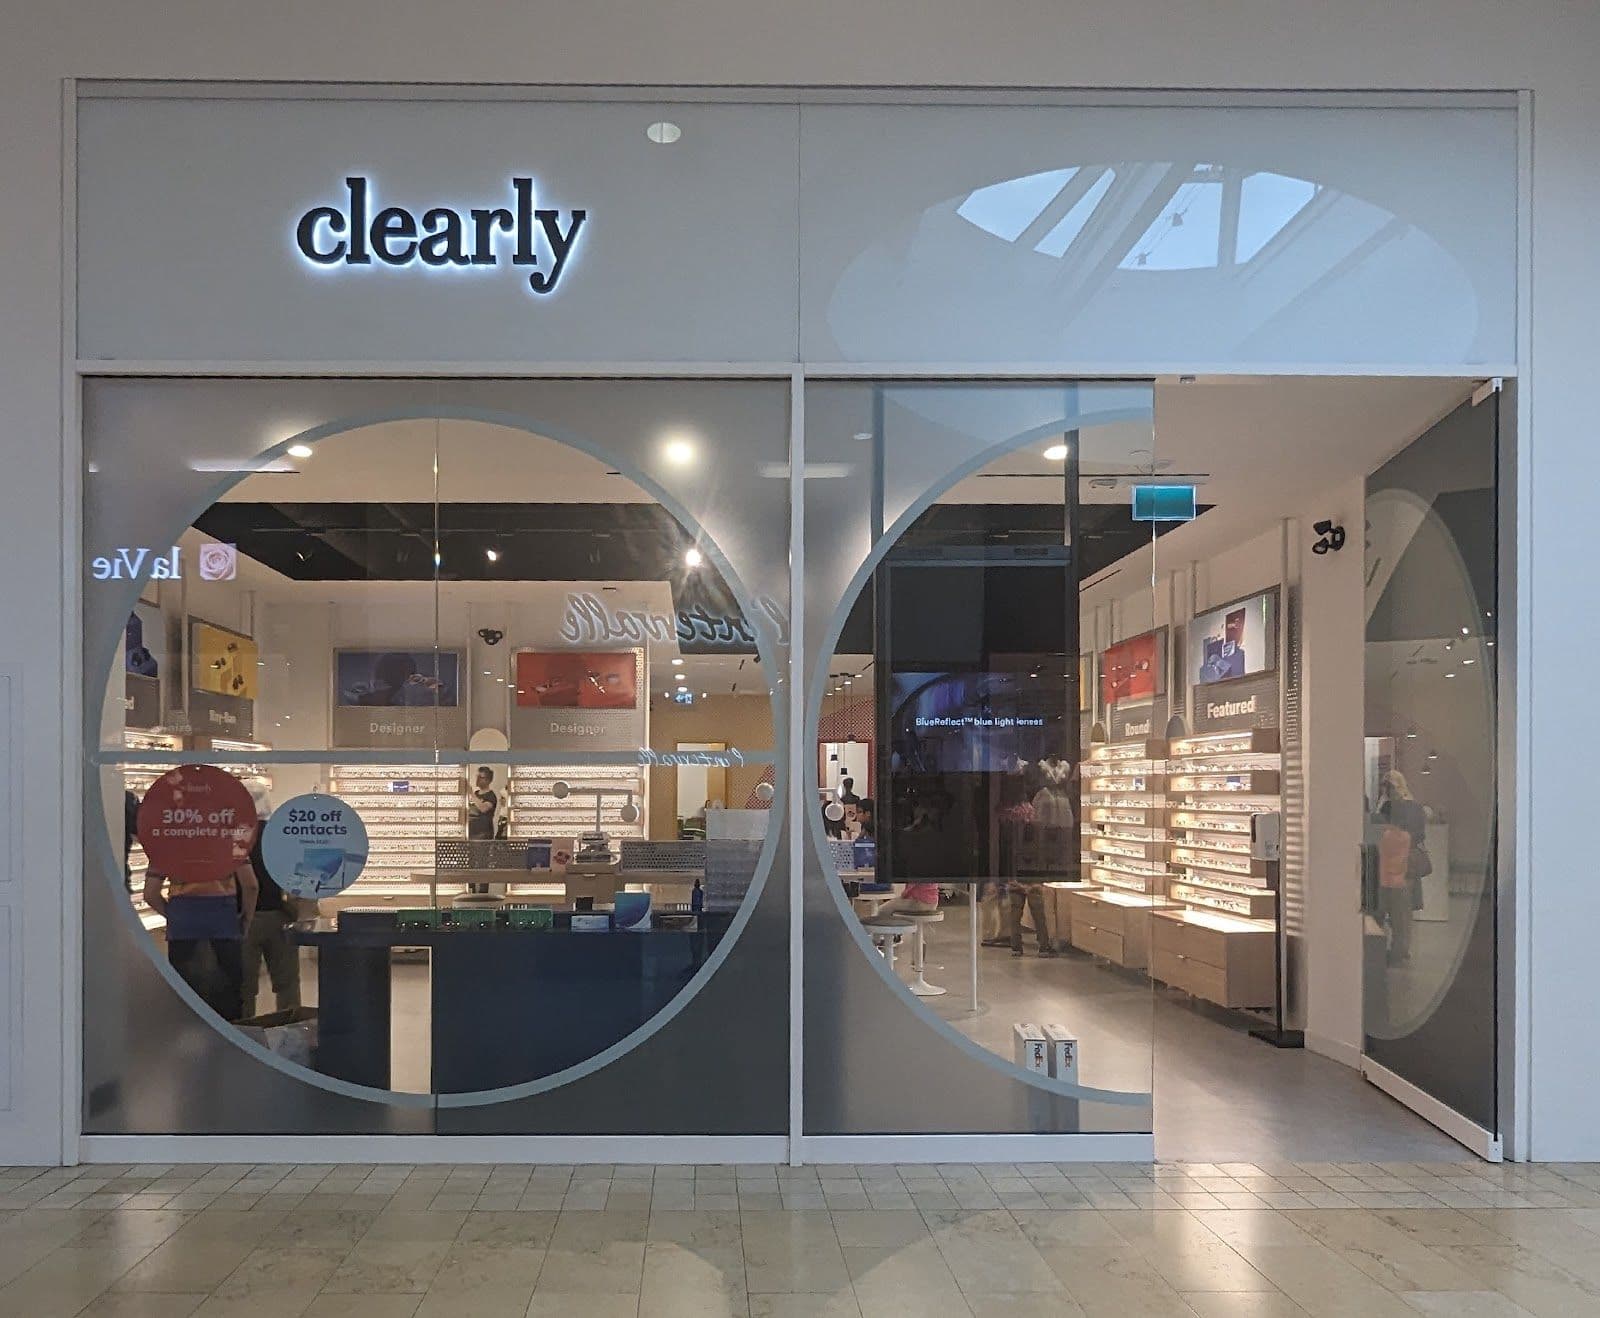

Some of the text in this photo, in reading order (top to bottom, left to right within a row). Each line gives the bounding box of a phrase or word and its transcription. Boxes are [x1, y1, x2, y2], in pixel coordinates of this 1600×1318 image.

[296, 176, 587, 294] clearly
[1207, 695, 1257, 719] Featured
[370, 722, 425, 737] Designer
[550, 721, 607, 736] Designer
[974, 717, 993, 727] blue
[995, 717, 1014, 728] light
[1125, 720, 1150, 737] Round
[162, 808, 236, 824] 30% off
[288, 809, 343, 824] $20 off
[152, 828, 160, 837] a
[163, 826, 217, 839] complete
[282, 823, 348, 836] contacts
[1034, 1043, 1043, 1068] FedEx
[1064, 1042, 1073, 1068] FedEx
